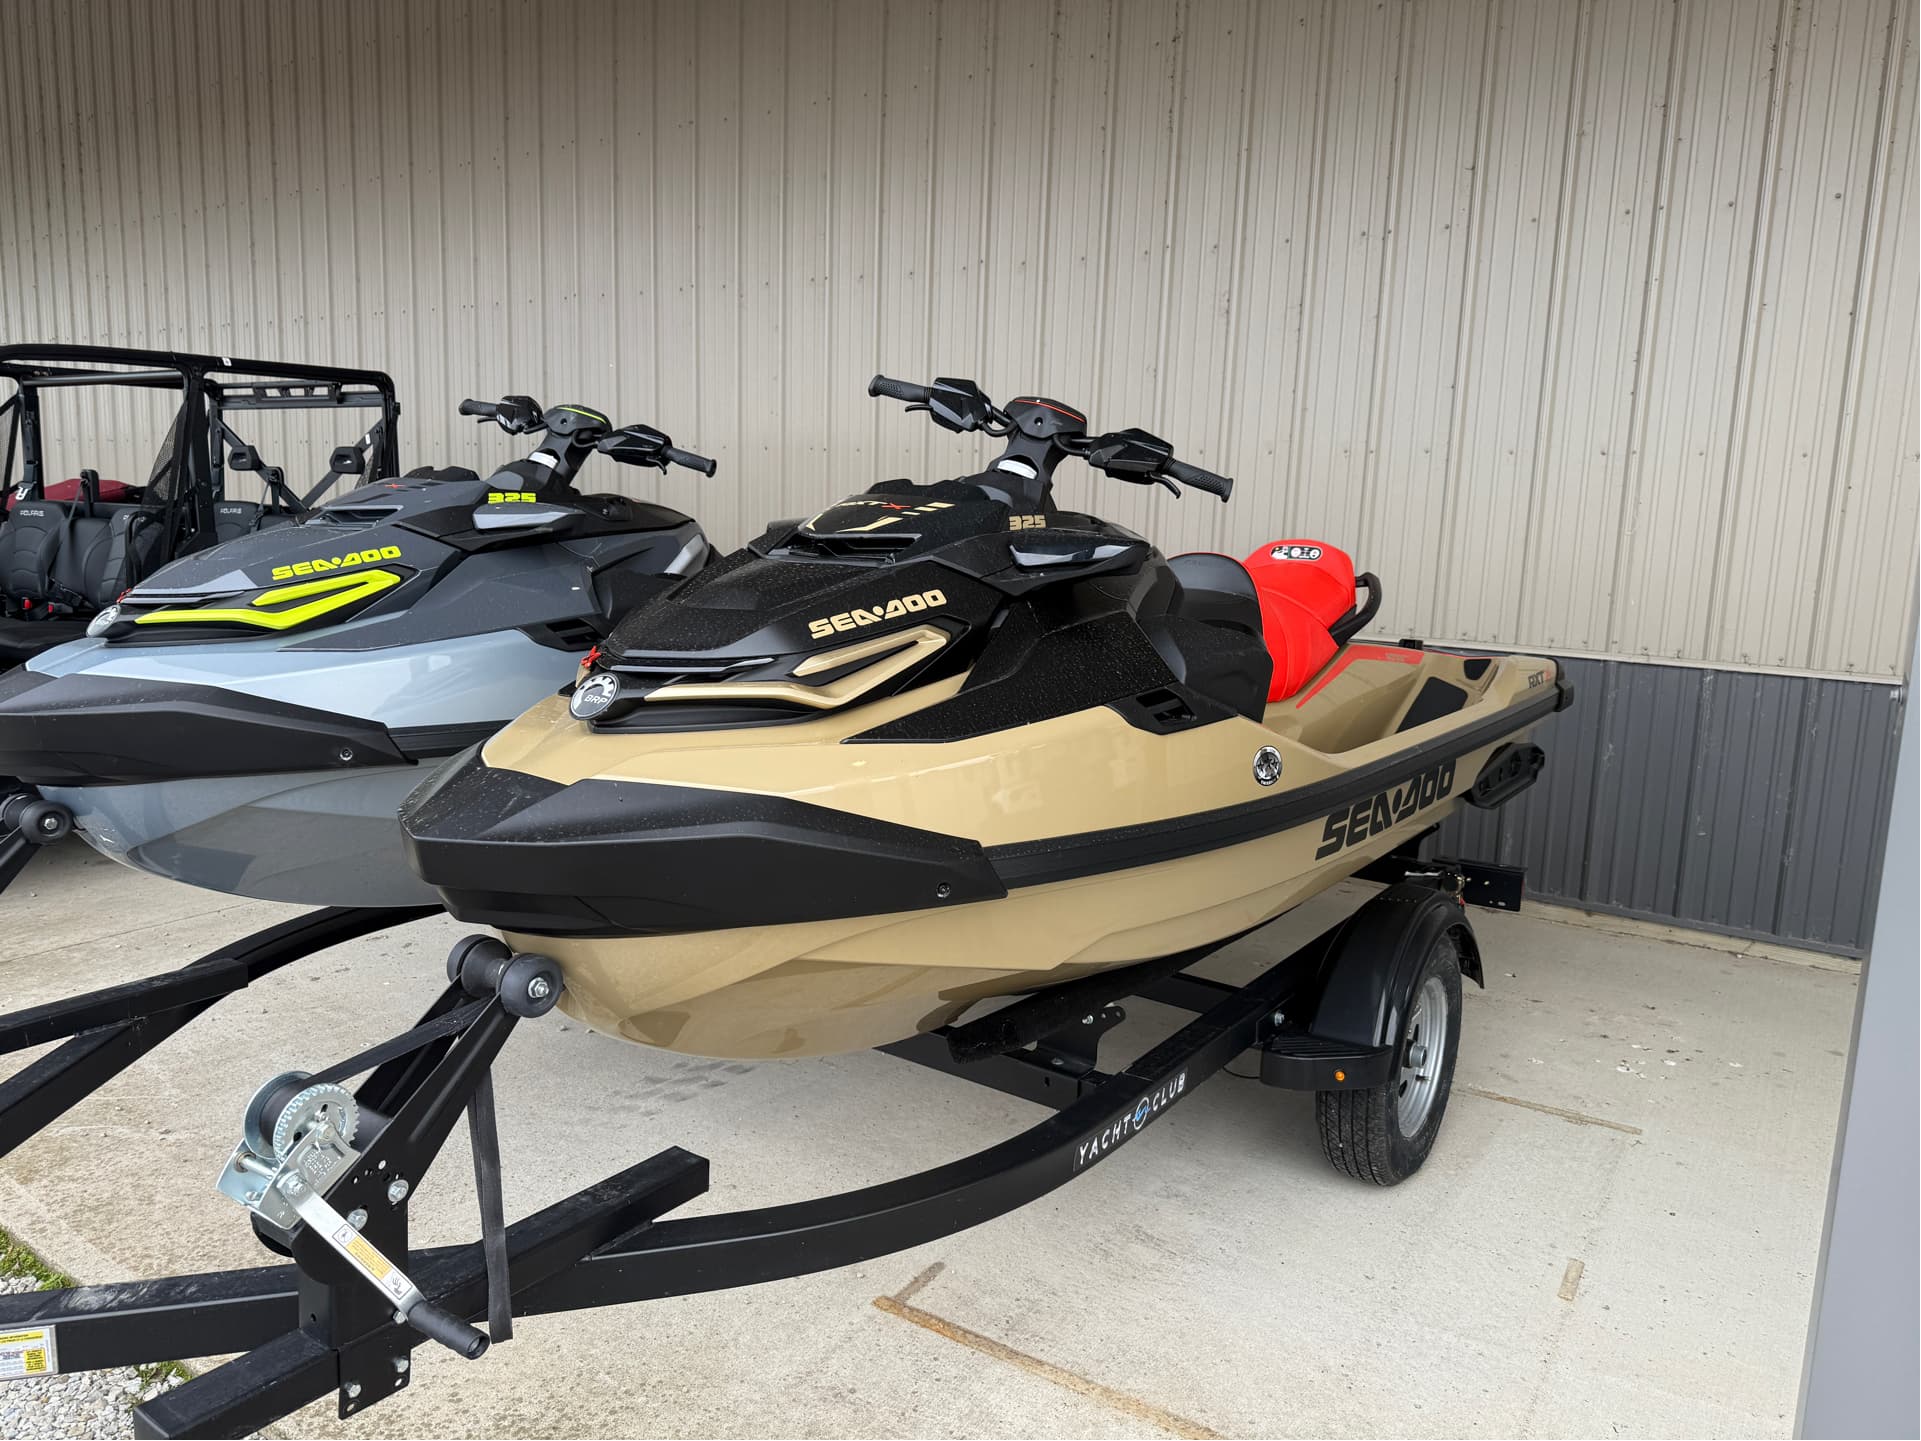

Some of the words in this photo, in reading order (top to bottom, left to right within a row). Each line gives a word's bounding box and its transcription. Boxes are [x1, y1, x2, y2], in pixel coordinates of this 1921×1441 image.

[488, 492, 537, 504] 325
[1009, 514, 1047, 531] 325
[584, 694, 609, 704] BRP
[1079, 1113, 1132, 1165] YACHT
[1152, 1072, 1186, 1111] CLUB
